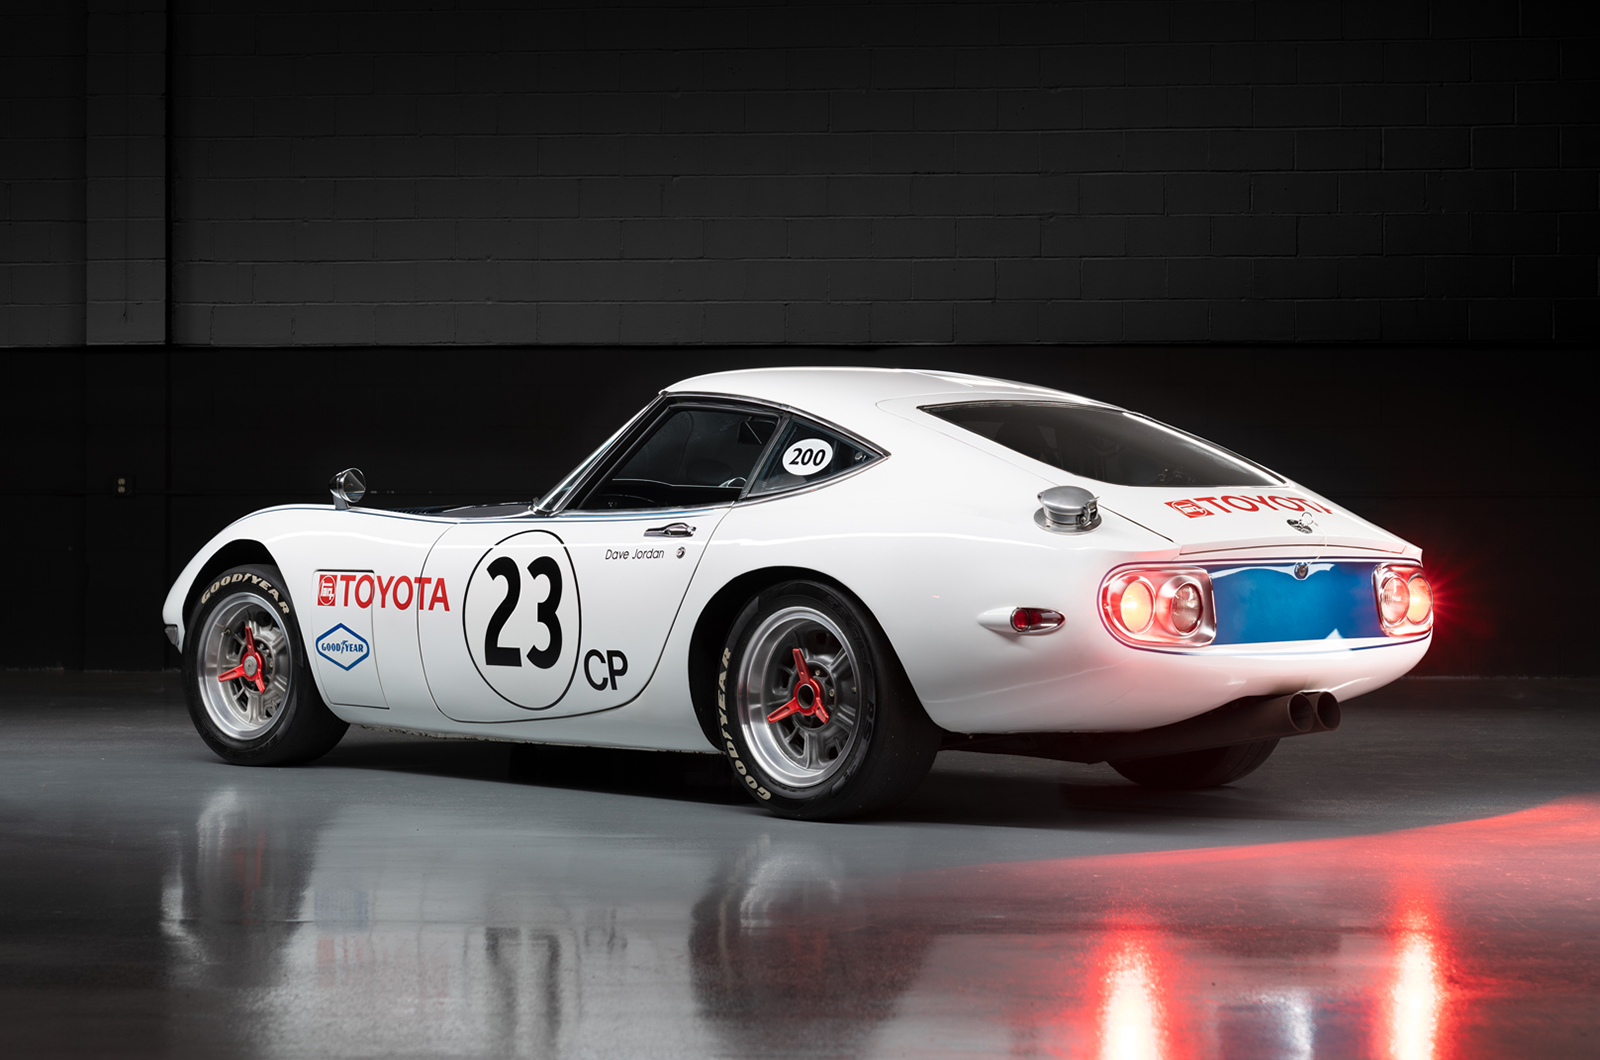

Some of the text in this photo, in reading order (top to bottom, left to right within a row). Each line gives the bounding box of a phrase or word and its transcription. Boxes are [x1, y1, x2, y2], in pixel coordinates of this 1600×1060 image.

[789, 447, 827, 467] 200
[604, 548, 665, 560] Dave Jordan
[201, 573, 291, 615] GOODYEAR
[339, 574, 451, 612] TOYOTA
[484, 556, 562, 669] 23
[321, 639, 364, 655] GOODYEAR
[583, 649, 628, 691] CP
[717, 647, 771, 801] GOODYEAR
